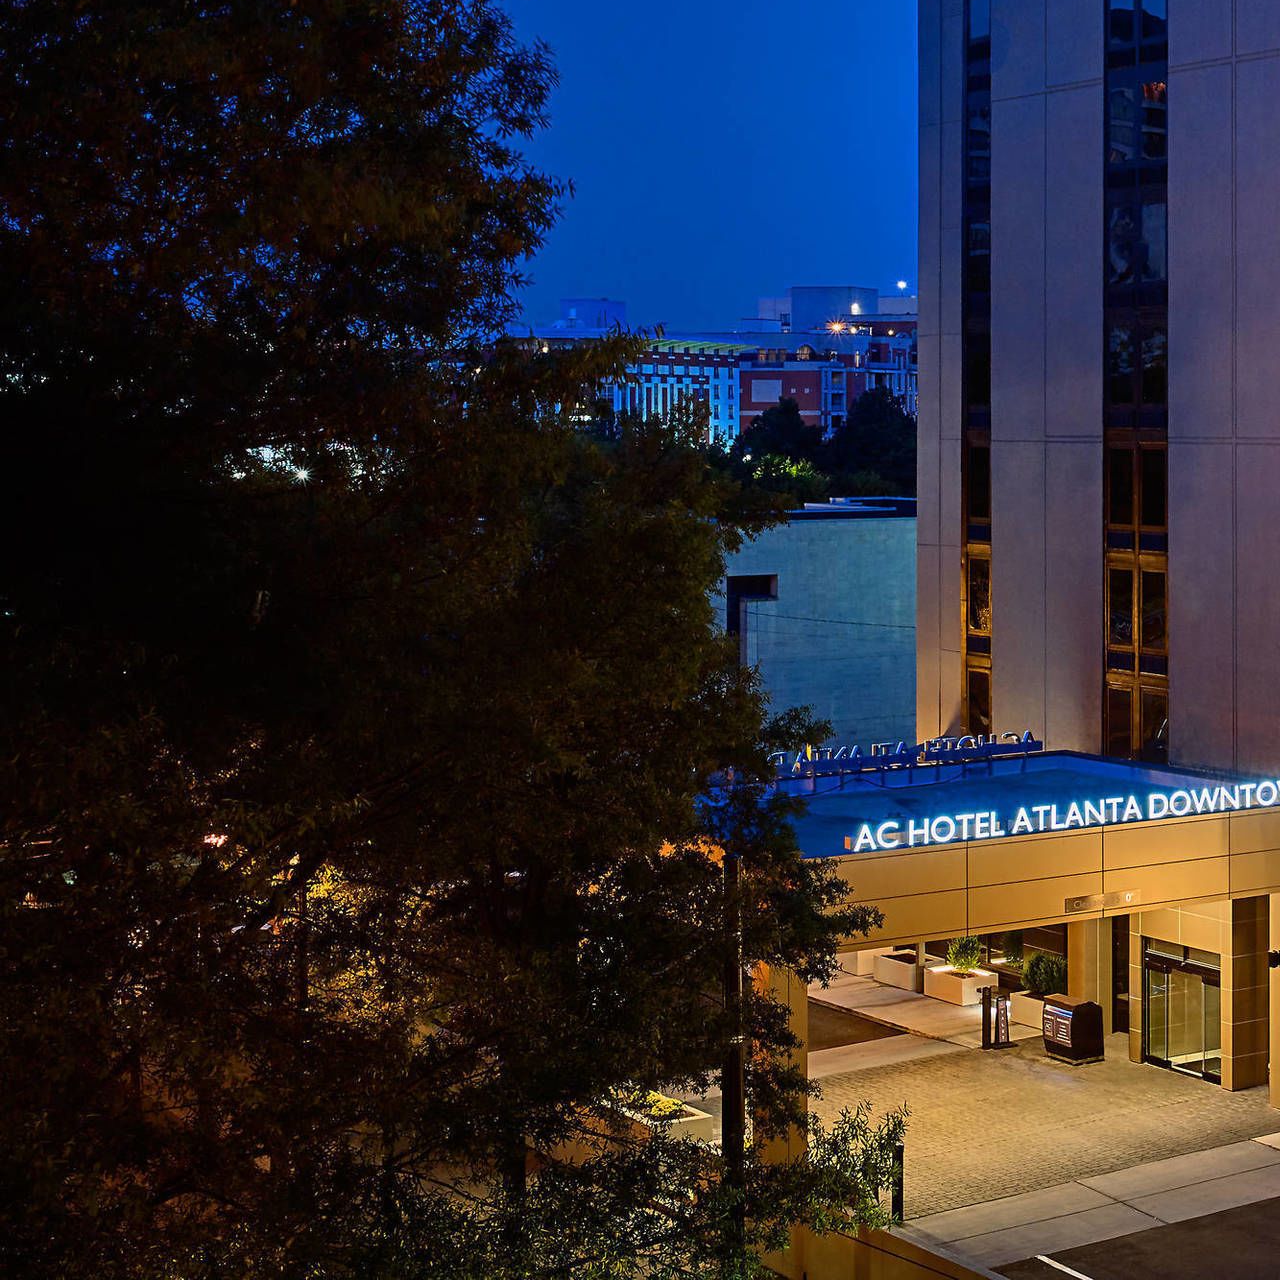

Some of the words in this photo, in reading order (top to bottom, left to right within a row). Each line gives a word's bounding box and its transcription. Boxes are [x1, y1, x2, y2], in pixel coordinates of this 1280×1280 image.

[853, 821, 899, 852] AC
[908, 811, 1005, 845] HOTEL
[1011, 795, 1143, 834] ATLANTA
